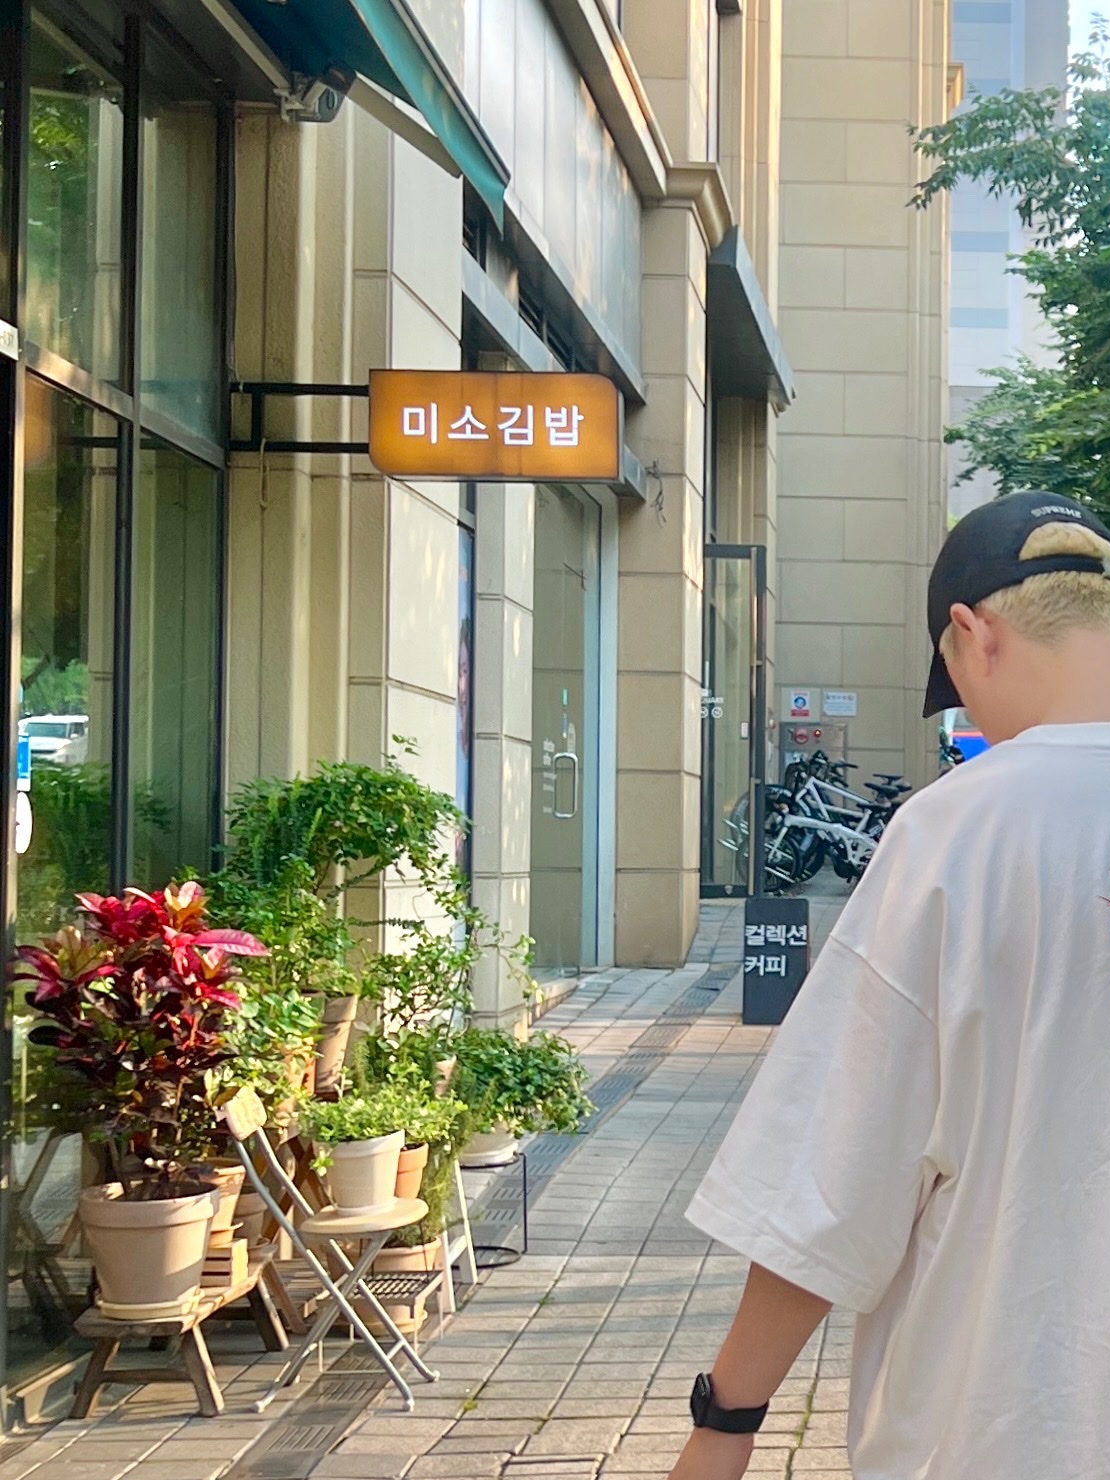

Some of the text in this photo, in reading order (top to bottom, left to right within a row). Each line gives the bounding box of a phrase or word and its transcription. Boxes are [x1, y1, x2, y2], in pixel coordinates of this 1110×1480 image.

[403, 402, 585, 446] 미소김밥
[1031, 505, 1082, 519] SUPREME
[744, 924, 808, 946] 컬렉션
[744, 954, 787, 977] 커피
